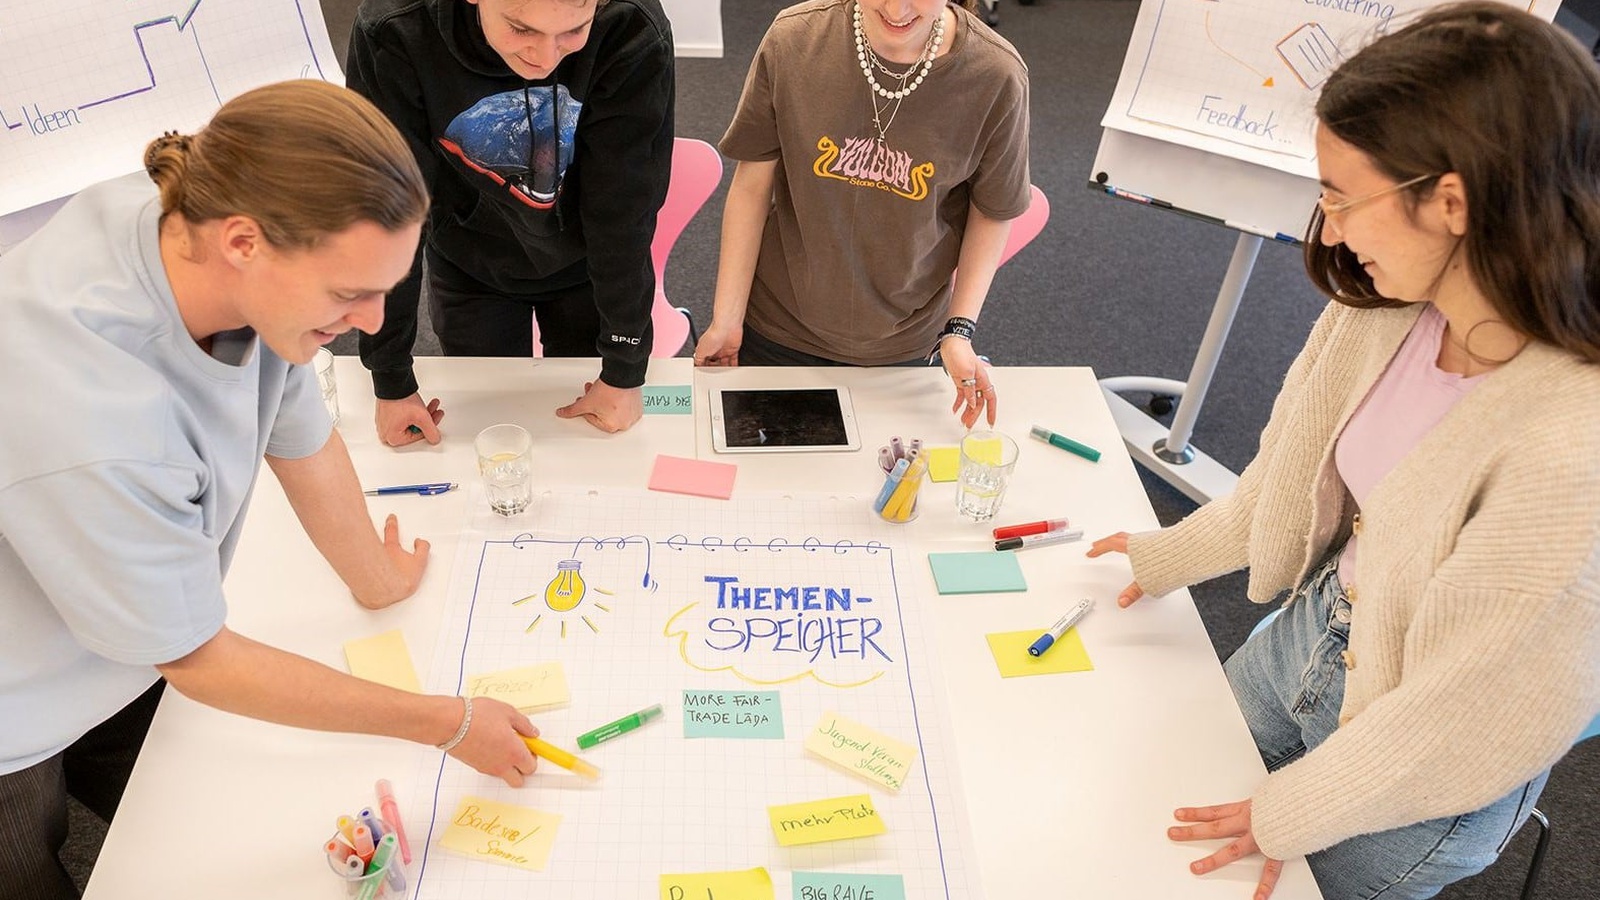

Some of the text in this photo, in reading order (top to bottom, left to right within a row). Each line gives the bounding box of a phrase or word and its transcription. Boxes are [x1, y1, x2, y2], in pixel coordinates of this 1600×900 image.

[22, 103, 81, 136] Ideen
[830, 136, 914, 193] VOLCOM
[849, 177, 891, 192] Stone Co.
[644, 395, 691, 407] BIG RAVE
[704, 575, 873, 611] THEMEN-
[684, 693, 726, 706] MORE
[687, 709, 730, 724] TRADE
[819, 719, 871, 748] Jugend
[780, 814, 834, 832] mehr
[801, 884, 874, 900] BIG RAVE
